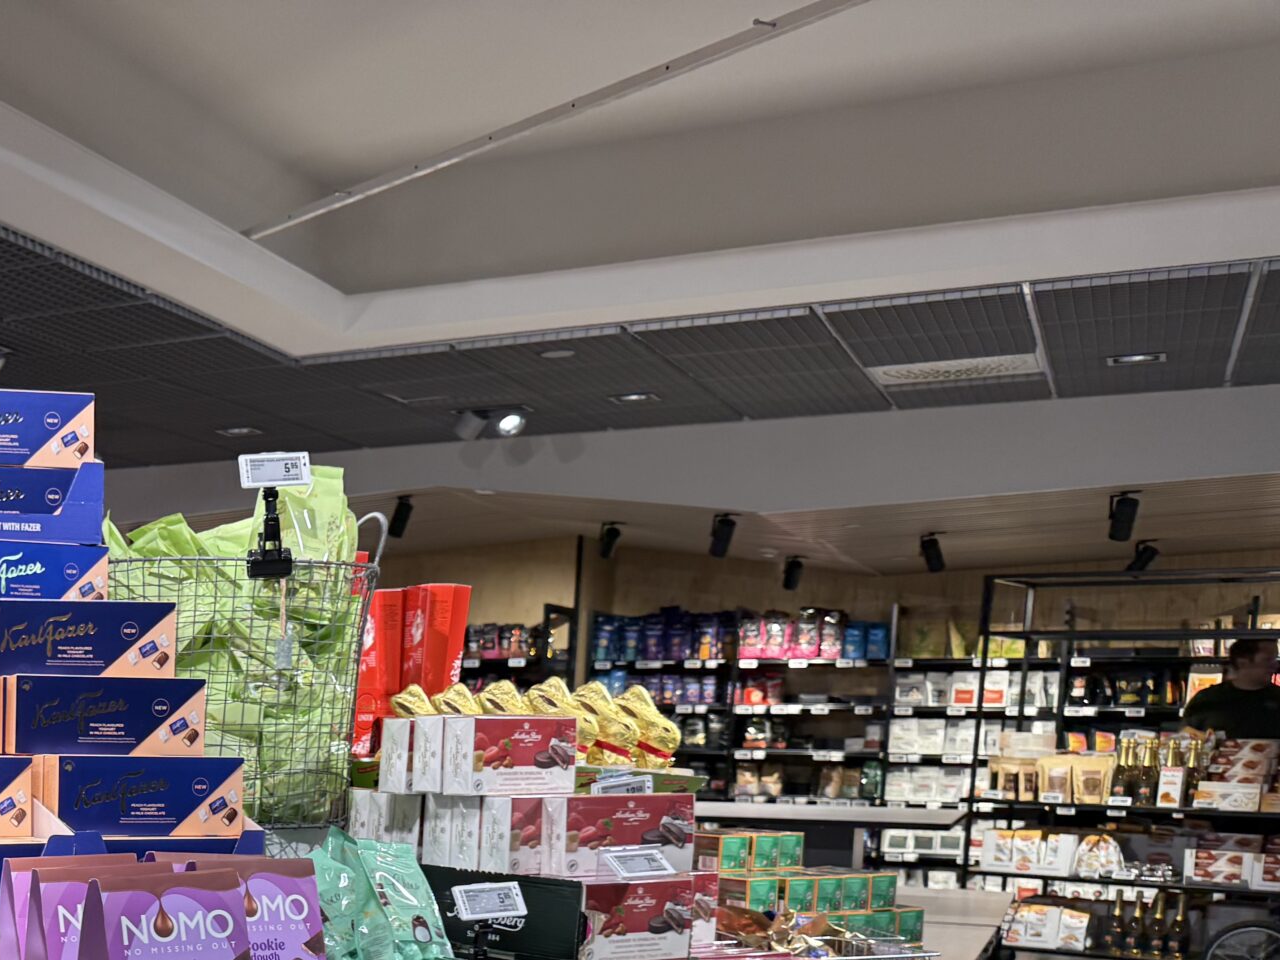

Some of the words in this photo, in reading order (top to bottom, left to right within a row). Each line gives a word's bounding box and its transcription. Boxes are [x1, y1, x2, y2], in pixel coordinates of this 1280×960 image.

[2, 522, 20, 531] WITH
[21, 522, 41, 532] FAZER
[121, 909, 234, 946] NOMO
[290, 922, 311, 931] OUT
[124, 948, 142, 957] NO
[151, 944, 203, 955] MISSING
[212, 941, 237, 950] OUT
